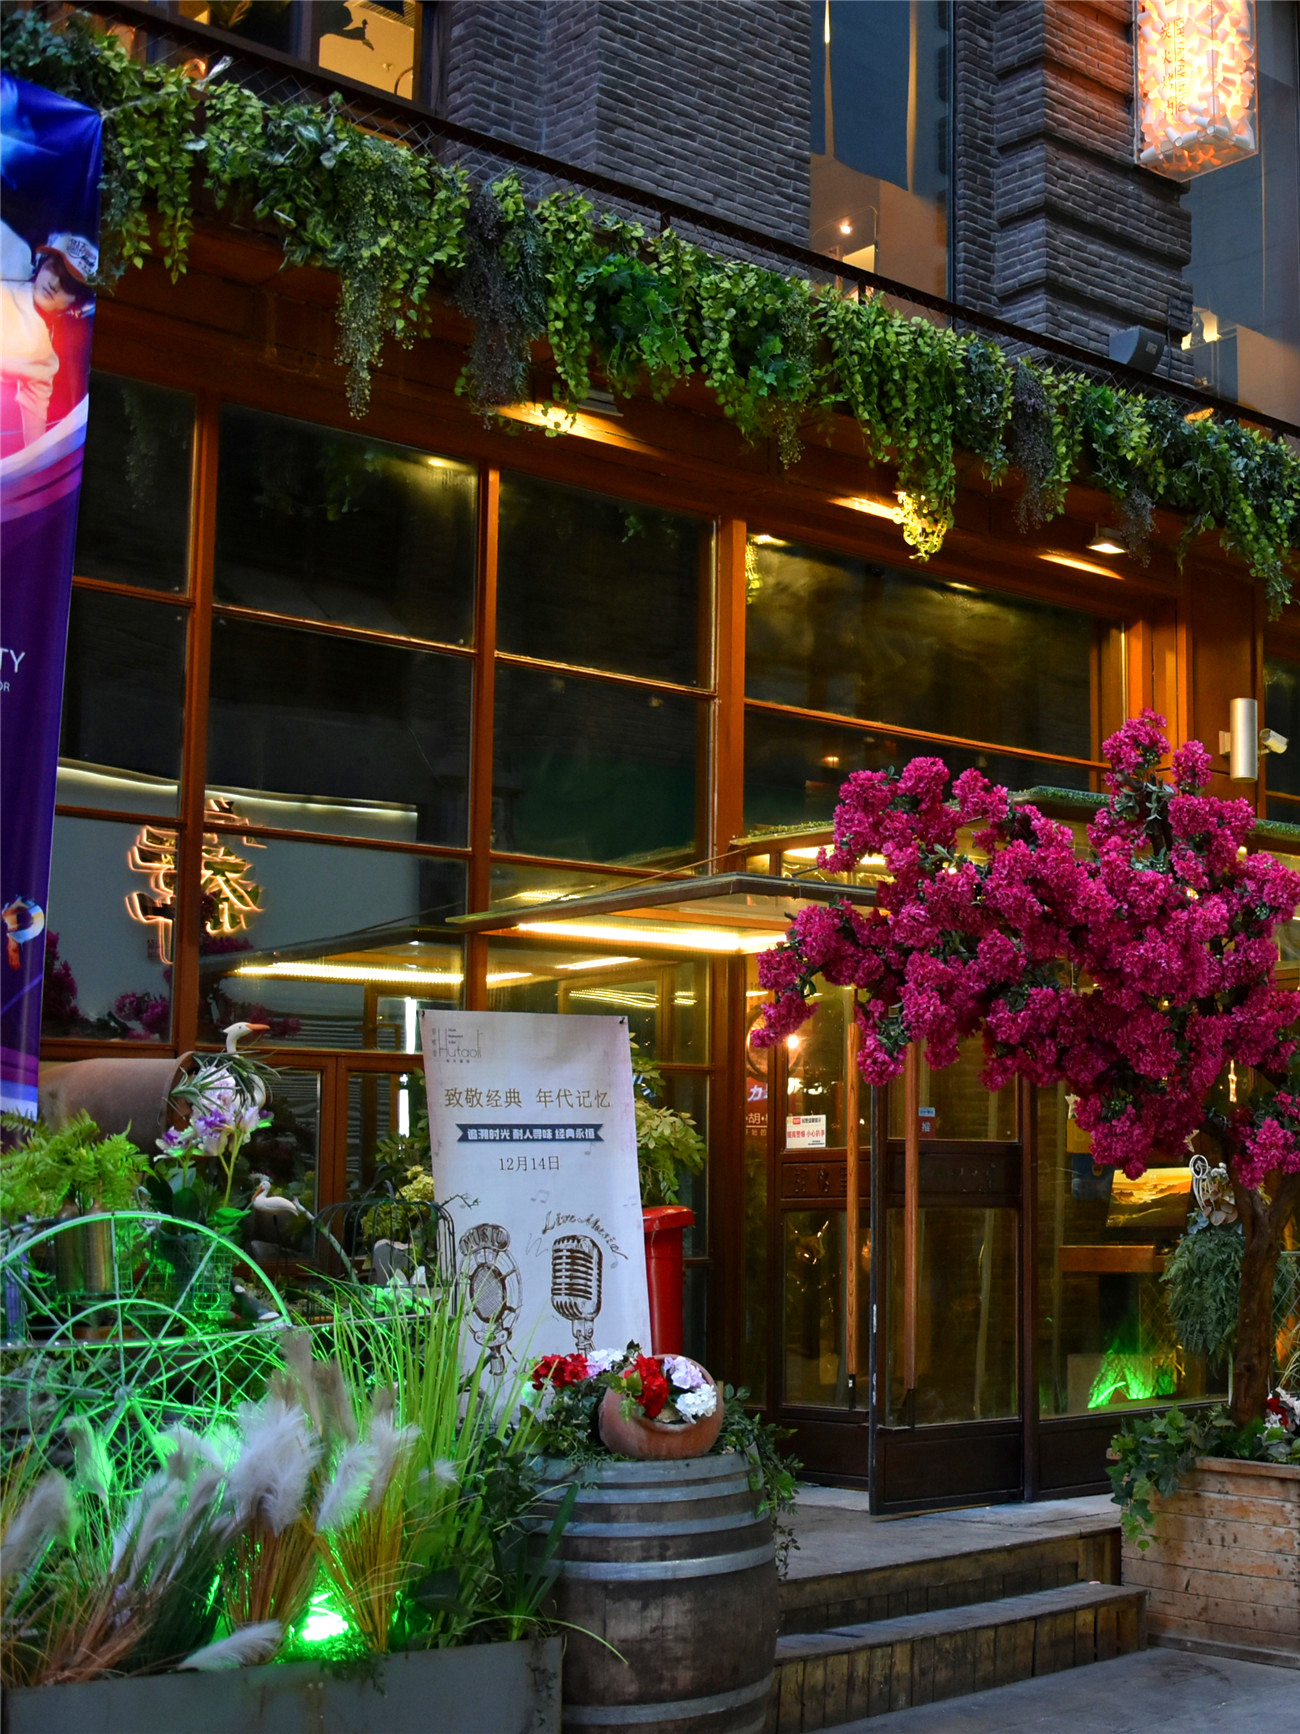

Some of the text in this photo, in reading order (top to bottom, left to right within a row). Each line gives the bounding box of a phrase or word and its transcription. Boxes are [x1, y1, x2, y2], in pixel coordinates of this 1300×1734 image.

[444, 1087, 611, 1109] 致敬经典 年代记忆
[512, 1128, 553, 1140] 耐人寻味
[555, 1128, 595, 1140] 经典永恒
[499, 1155, 560, 1172] 12月14日
